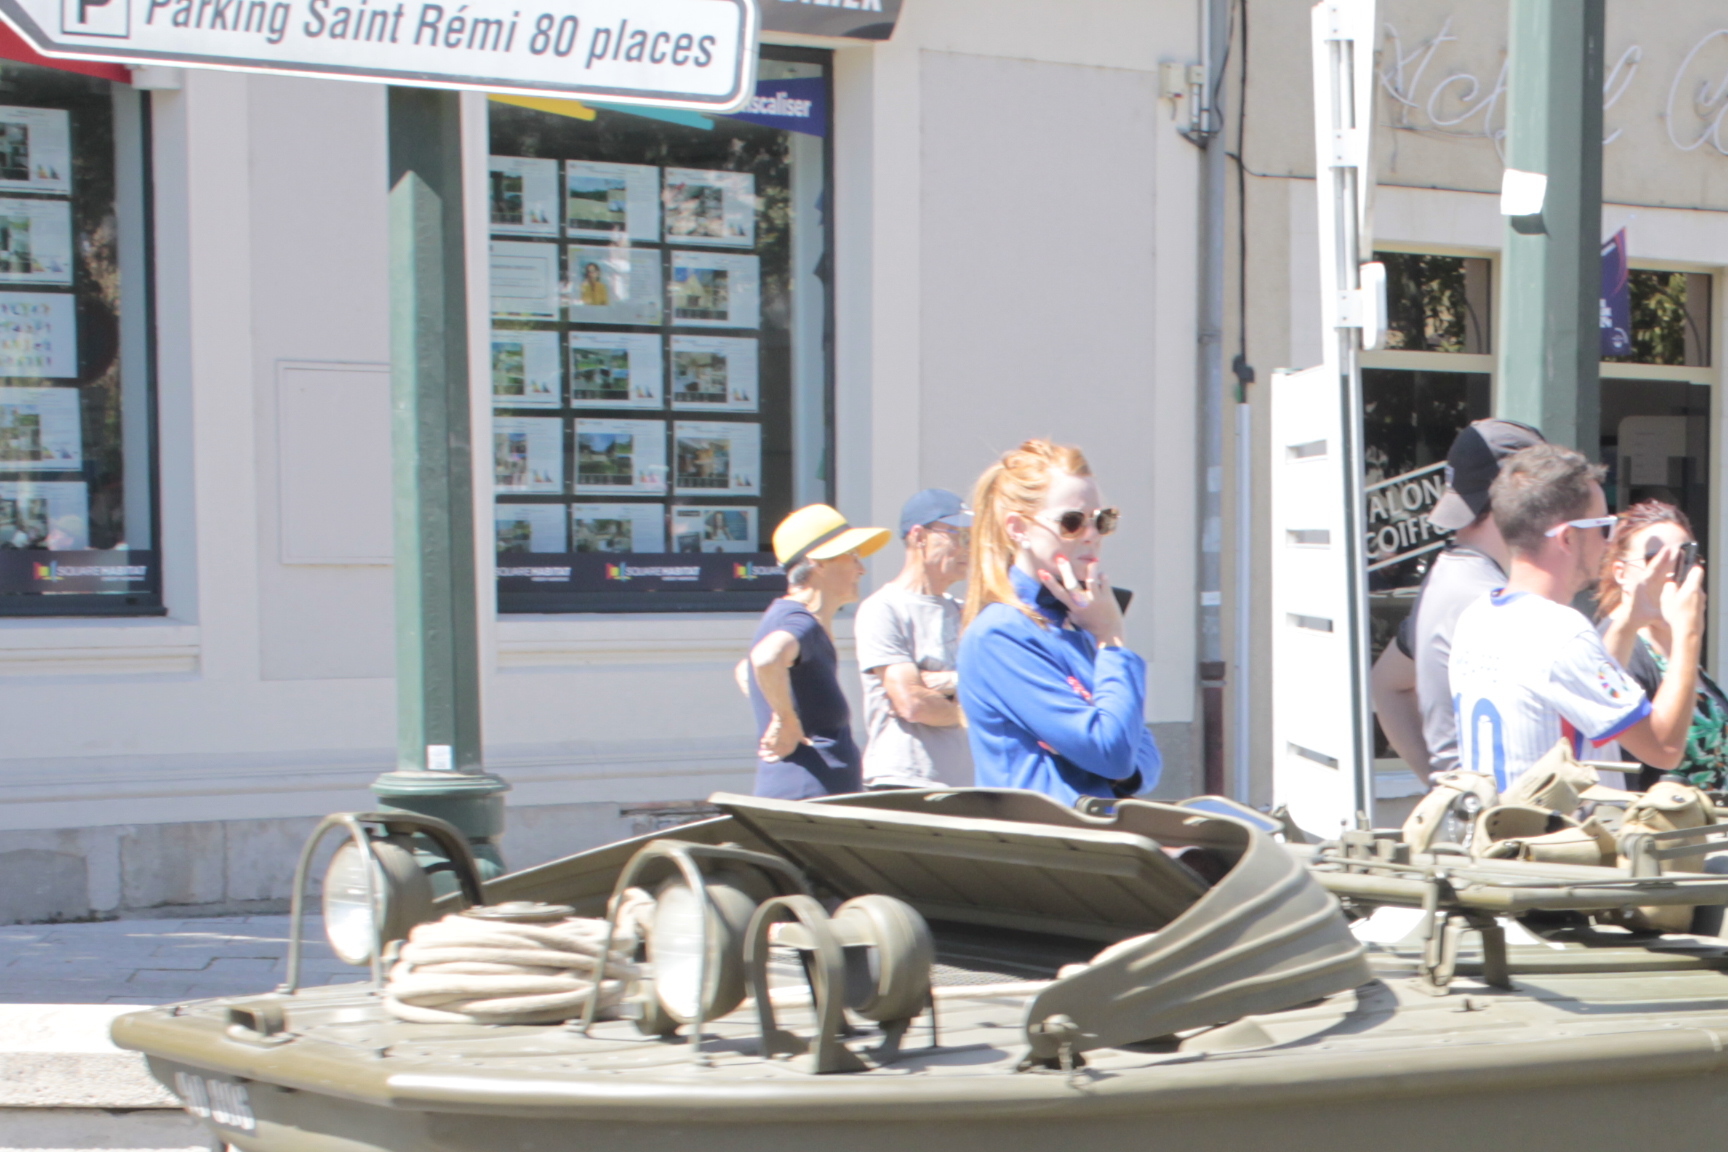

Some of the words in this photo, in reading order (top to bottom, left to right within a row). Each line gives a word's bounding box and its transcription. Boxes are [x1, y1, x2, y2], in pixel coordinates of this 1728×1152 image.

[146, 0, 291, 44] Parking
[303, 0, 404, 44] Saint
[413, 3, 518, 52] Rémi
[529, 12, 578, 57] 80
[585, 18, 717, 68] places
[1369, 475, 1441, 523] ALON
